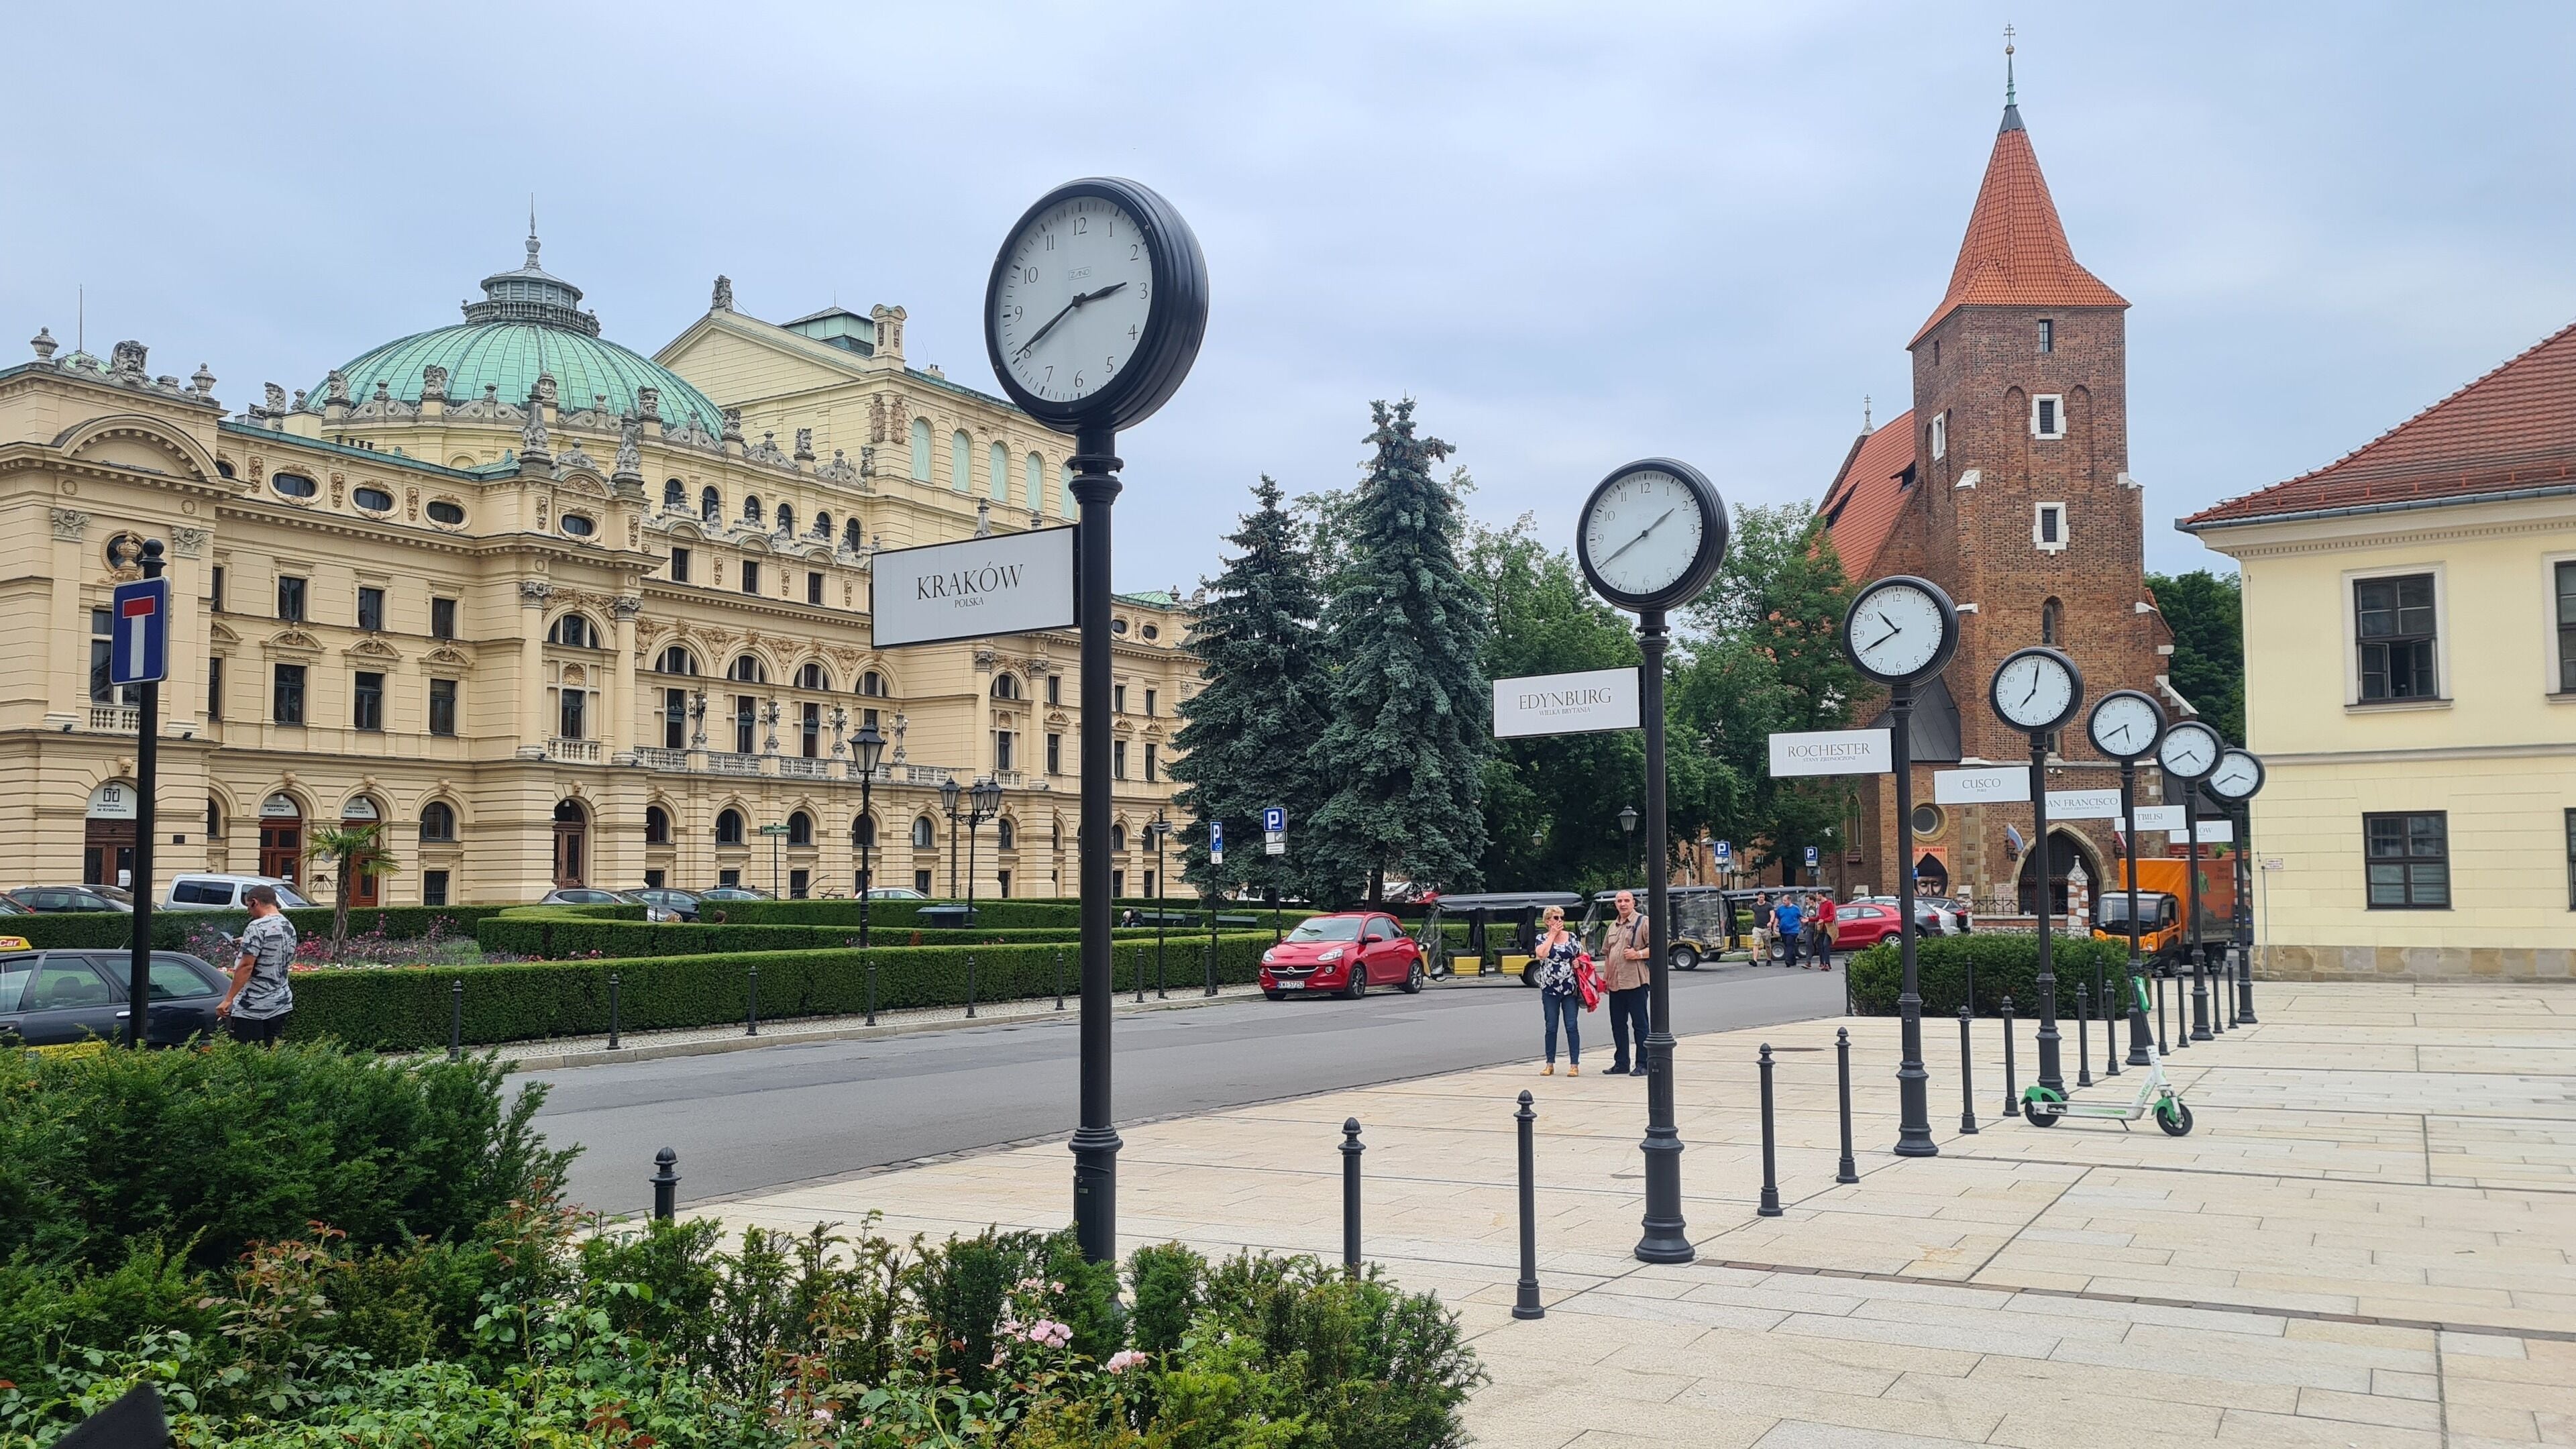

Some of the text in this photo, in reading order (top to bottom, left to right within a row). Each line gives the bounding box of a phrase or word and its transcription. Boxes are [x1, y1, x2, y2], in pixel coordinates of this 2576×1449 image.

[1074, 217, 1087, 235] 12
[1109, 221, 1112, 237] 1
[1046, 234, 1054, 251] 11
[1130, 244, 1138, 261] 2
[1024, 266, 1038, 284] 10
[1140, 282, 1148, 299] 3
[1014, 306, 1022, 322] 9
[1128, 323, 1138, 340] 4
[1024, 343, 1032, 359] 8
[1106, 356, 1114, 373] 5
[1045, 366, 1053, 382] 7
[1075, 370, 1083, 388] 6
[1641, 483, 1651, 494] 12
[1666, 486, 1669, 496] 1
[1621, 492, 1627, 502] 11
[1682, 500, 1688, 511] 2
[1605, 511, 1615, 521] 10
[1690, 524, 1695, 535] 3
[1598, 534, 1604, 543] 9
[1681, 549, 1687, 558] 4
[1621, 572, 1627, 581] 7
[1666, 568, 1672, 577] 5
[917, 561, 1024, 600] KRAKÓW
[1644, 576, 1650, 586] 6
[955, 597, 983, 608] POLSKA
[1896, 661, 1901, 669] 6
[1519, 688, 1611, 710] EDYNBURG
[1788, 743, 1870, 757] ROCHESTER
[1962, 778, 2001, 788] CUSCO
[2046, 798, 2118, 808] AN FRANCISCO
[1268, 811, 1279, 829] P
[1214, 825, 1220, 843] P
[1717, 843, 1726, 855] P
[1807, 849, 1814, 859] P
